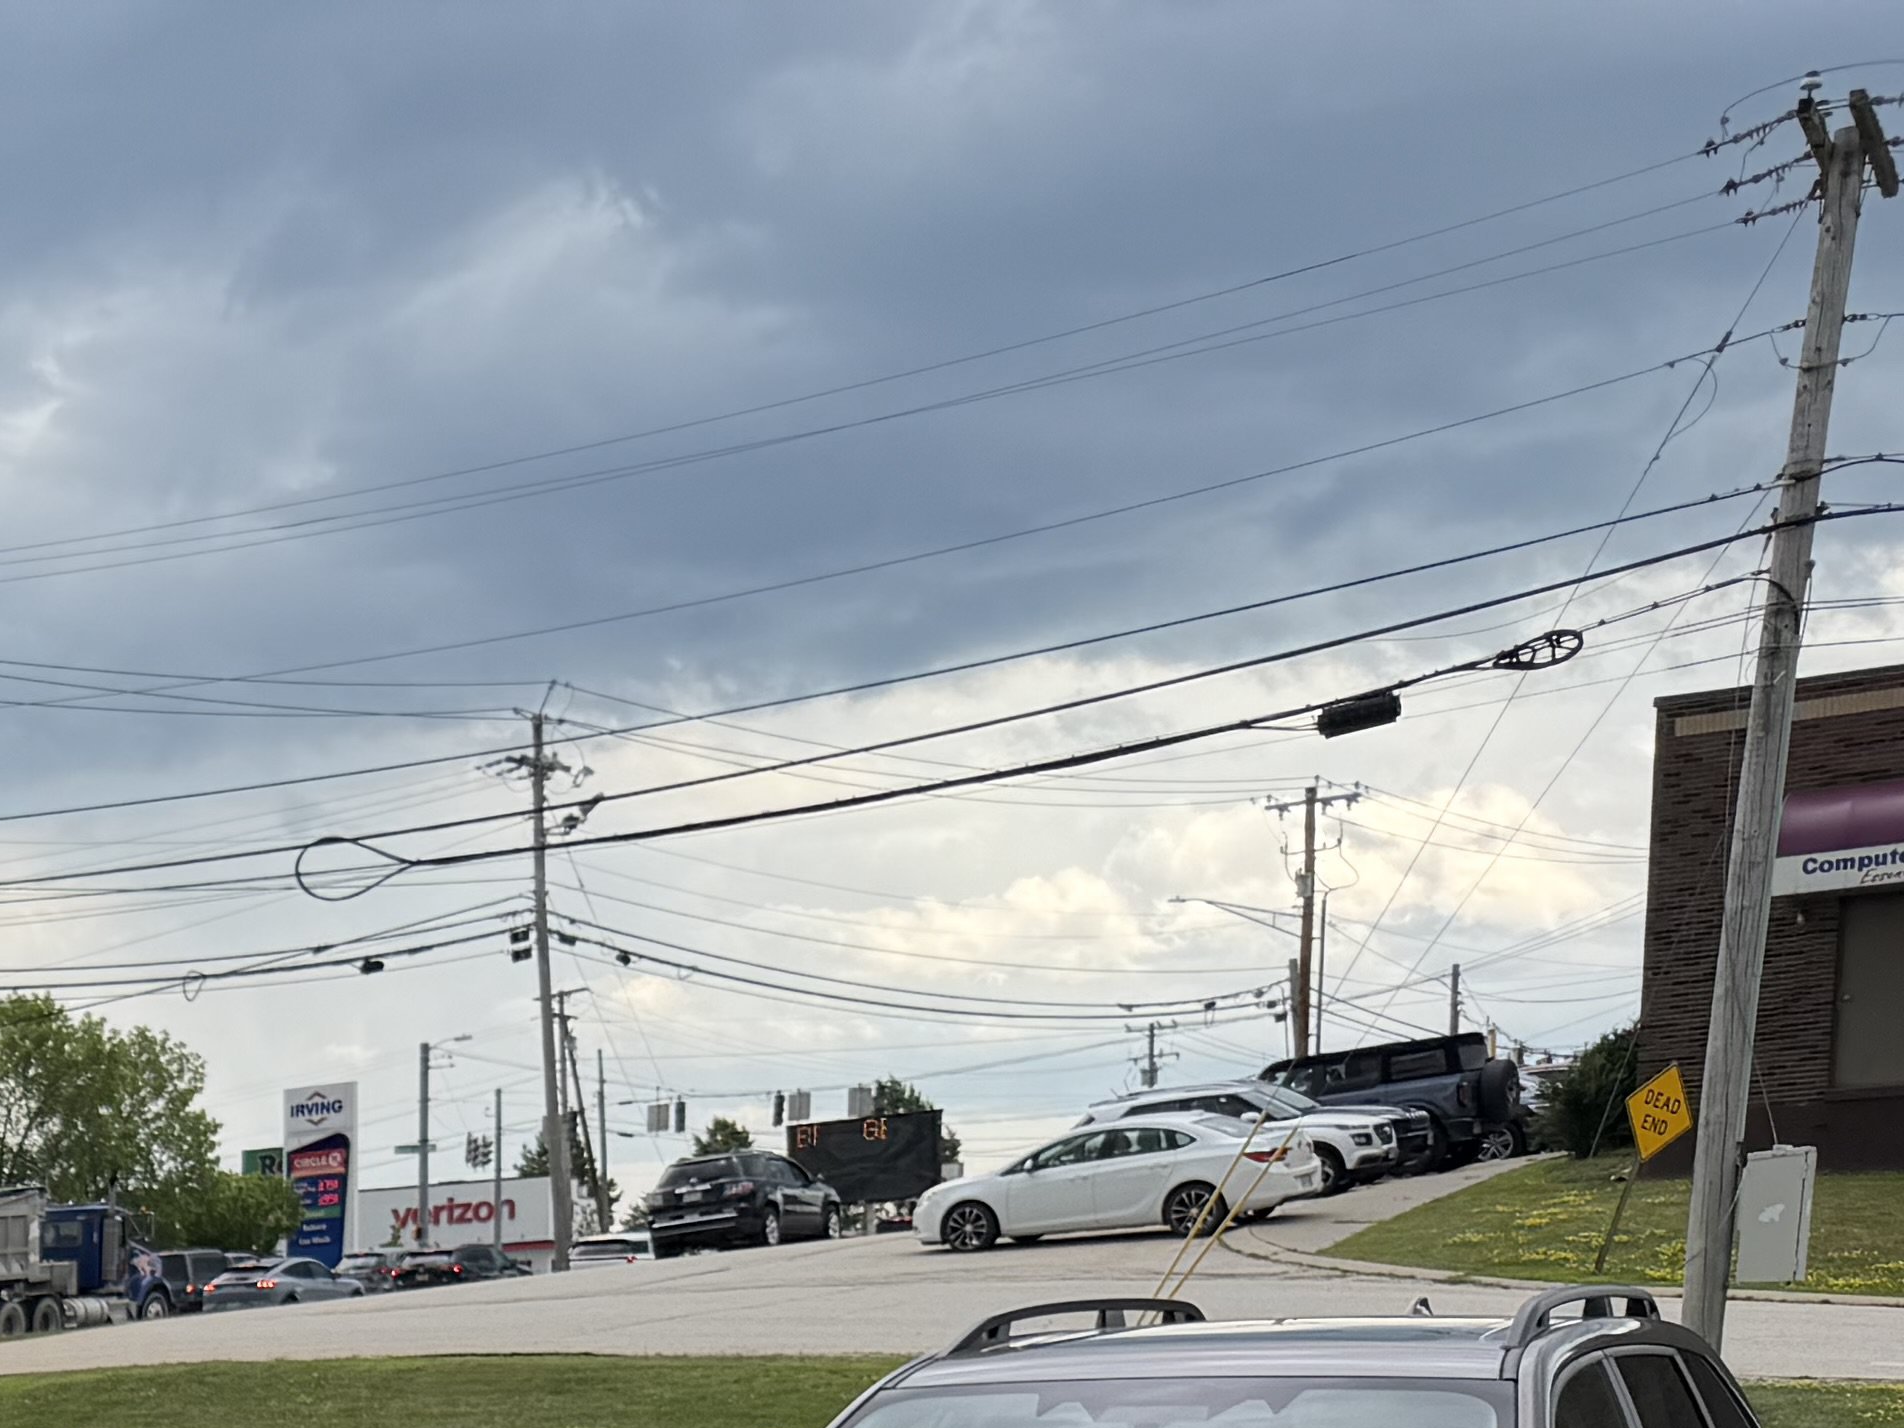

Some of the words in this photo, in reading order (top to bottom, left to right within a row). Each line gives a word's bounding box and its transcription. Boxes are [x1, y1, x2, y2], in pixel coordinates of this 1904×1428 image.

[290, 1099, 343, 1118] IRVING
[1644, 1089, 1681, 1115] DEAD
[1641, 1114, 1668, 1136] END
[391, 1197, 516, 1229] verizon
